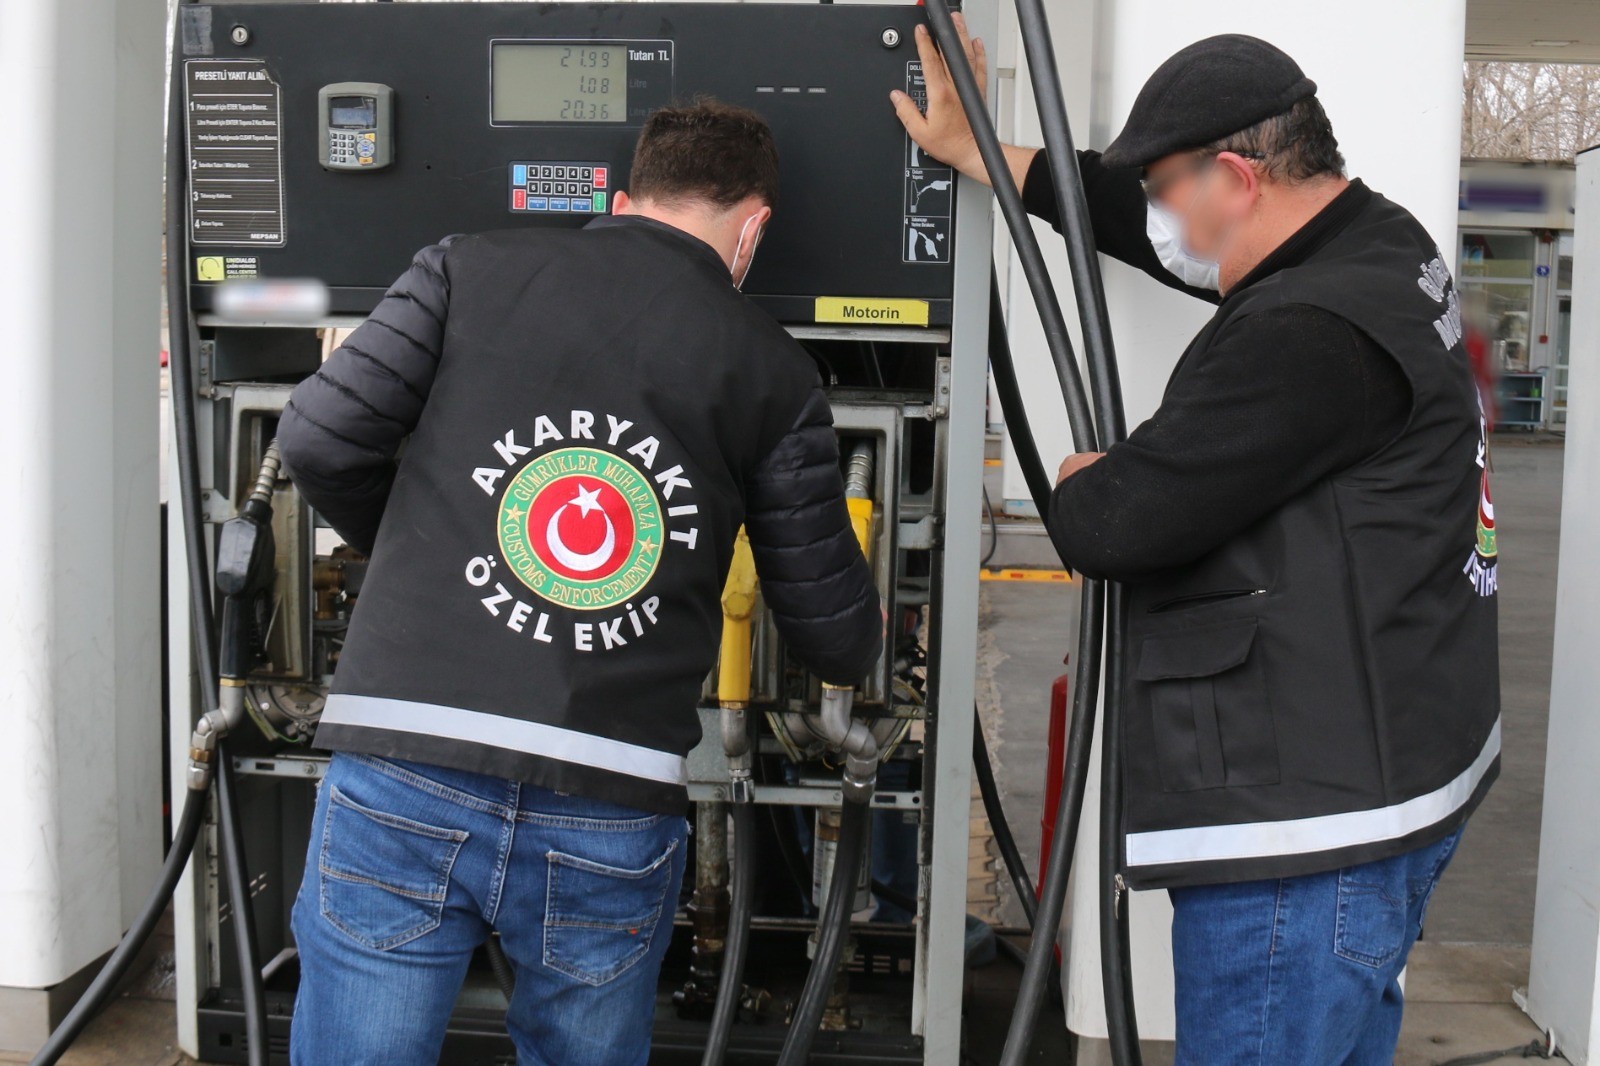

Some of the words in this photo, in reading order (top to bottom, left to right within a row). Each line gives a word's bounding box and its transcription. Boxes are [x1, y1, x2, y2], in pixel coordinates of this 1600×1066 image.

[560, 48, 610, 68] 21.99
[628, 50, 654, 61] Tutarı
[658, 50, 670, 61] TL
[194, 69, 227, 80] PRESETLİ
[228, 71, 247, 80] YAKIT
[580, 76, 610, 94] 1.08
[190, 101, 194, 112] 1
[560, 100, 609, 120] 20.36
[192, 159, 197, 170] 2
[192, 191, 198, 202] 3
[194, 218, 200, 229] 4
[842, 305, 900, 320] Motorin
[472, 410, 698, 550] AKARYAKIT
[514, 454, 598, 501] GÜMRÜKLER
[602, 460, 657, 530] MUHAFAZA
[504, 524, 547, 588] CUSTOMS
[549, 554, 652, 604] ENFORCEMENT
[465, 554, 553, 644] ÖZEL
[574, 595, 660, 652] EKİP
